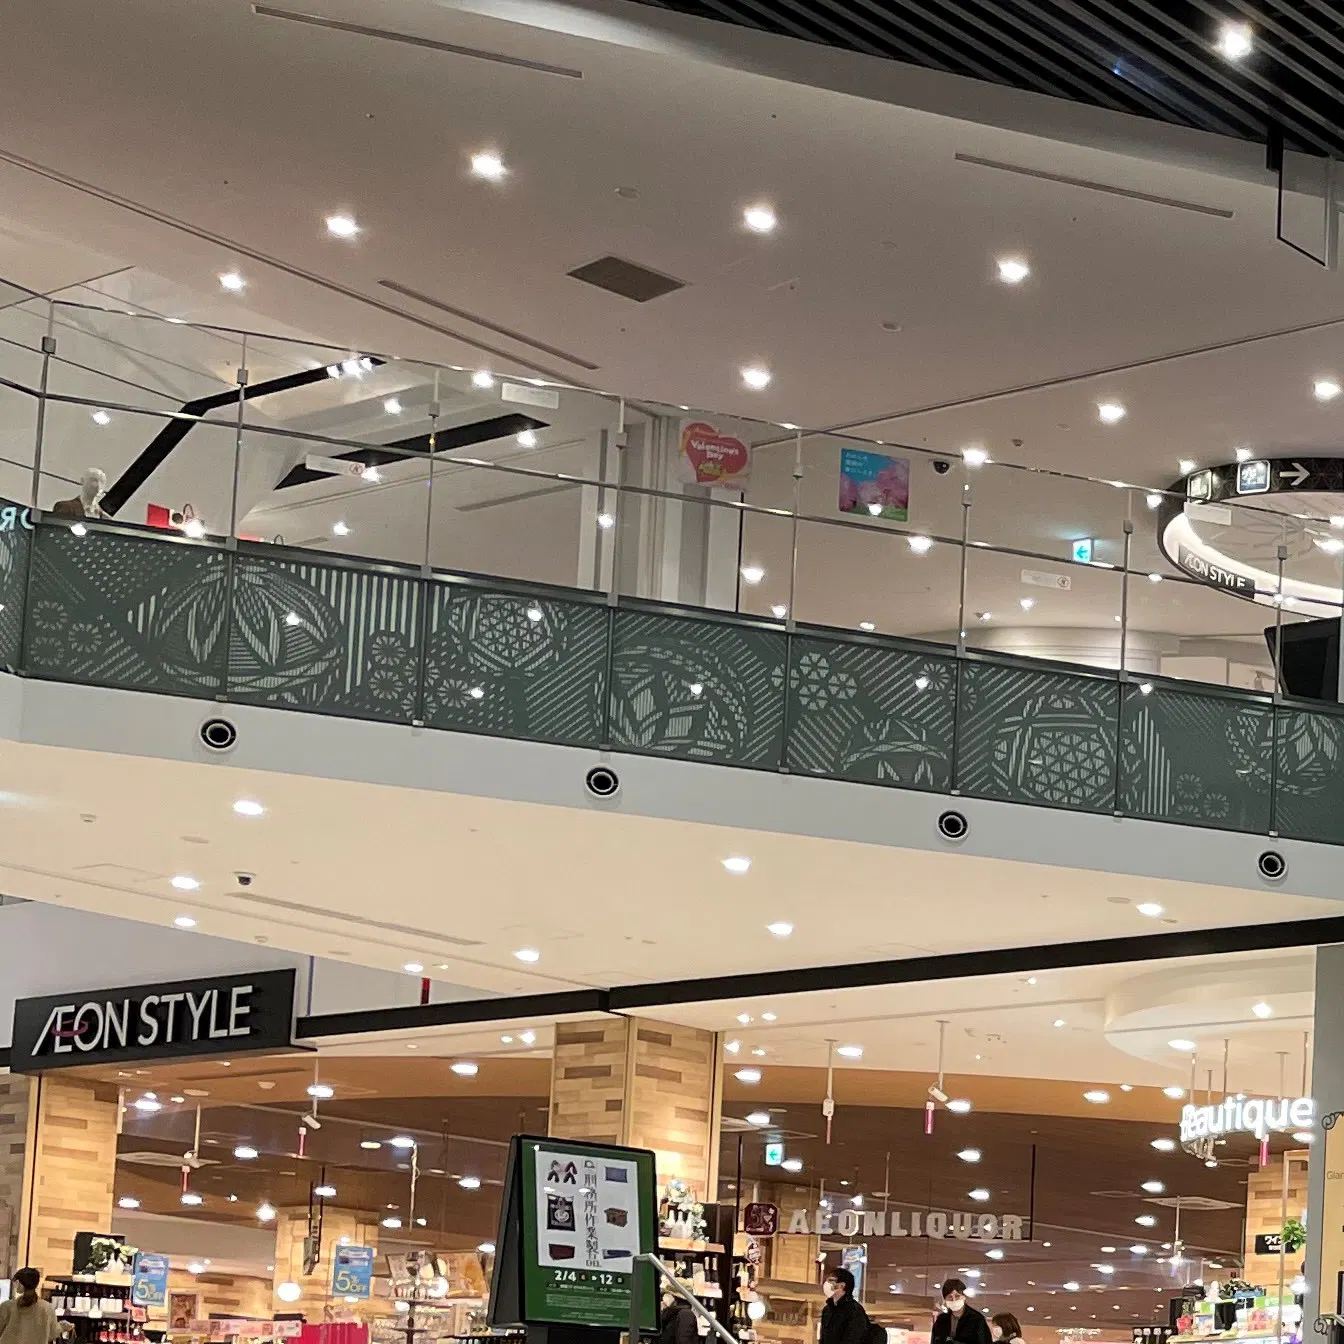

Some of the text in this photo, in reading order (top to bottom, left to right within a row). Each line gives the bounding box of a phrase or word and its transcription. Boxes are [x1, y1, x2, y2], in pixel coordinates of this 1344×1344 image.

[137, 985, 253, 1046] STYLE
[554, 1270, 577, 1282] 2/4
[600, 1274, 613, 1285] 12
